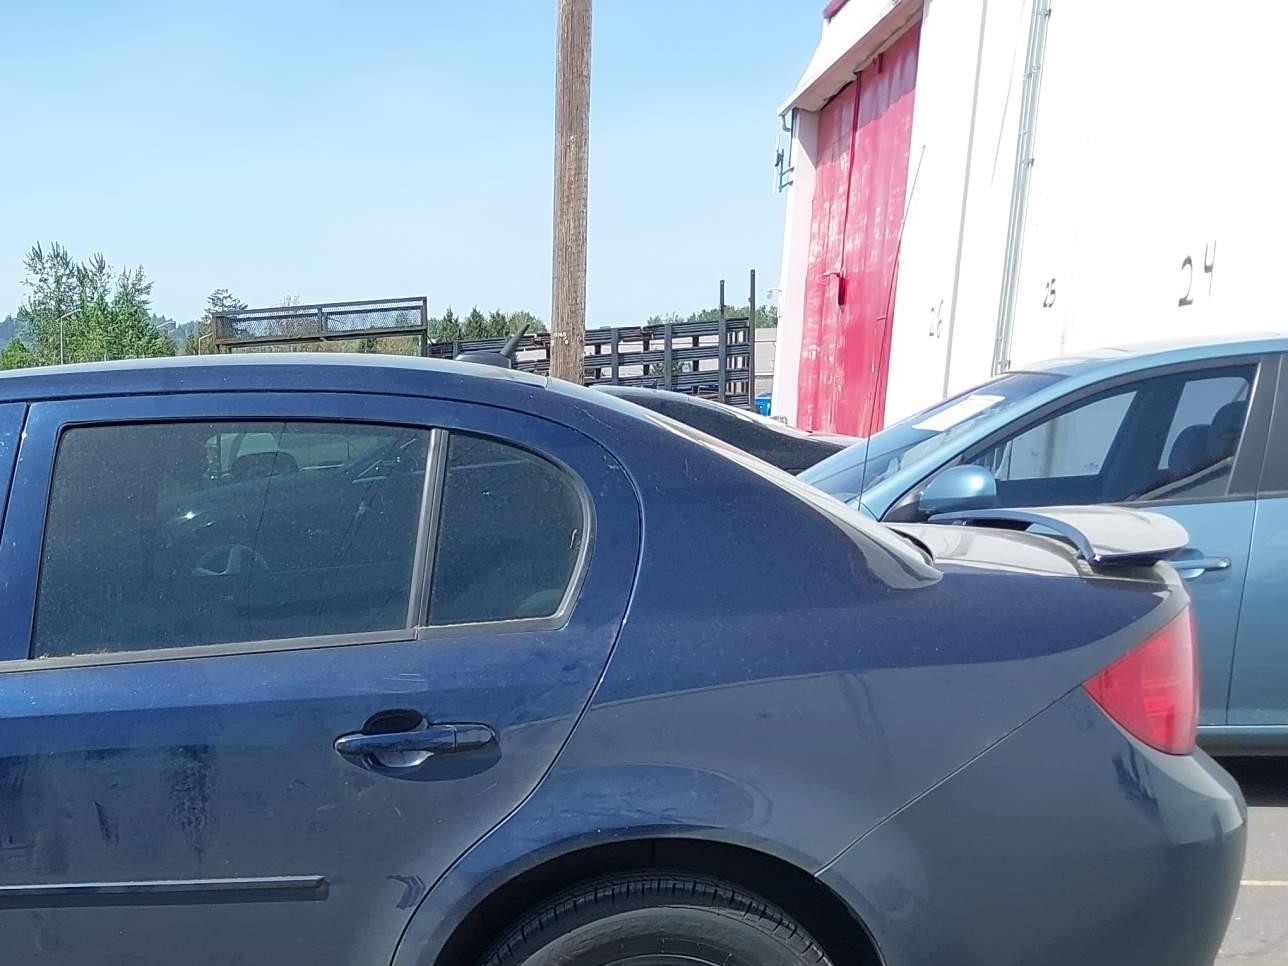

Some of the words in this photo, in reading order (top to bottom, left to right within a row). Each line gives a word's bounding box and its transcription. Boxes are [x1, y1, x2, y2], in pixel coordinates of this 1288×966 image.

[1042, 277, 1057, 309] 25
[1178, 239, 1217, 307] 24
[928, 298, 944, 339] 26
